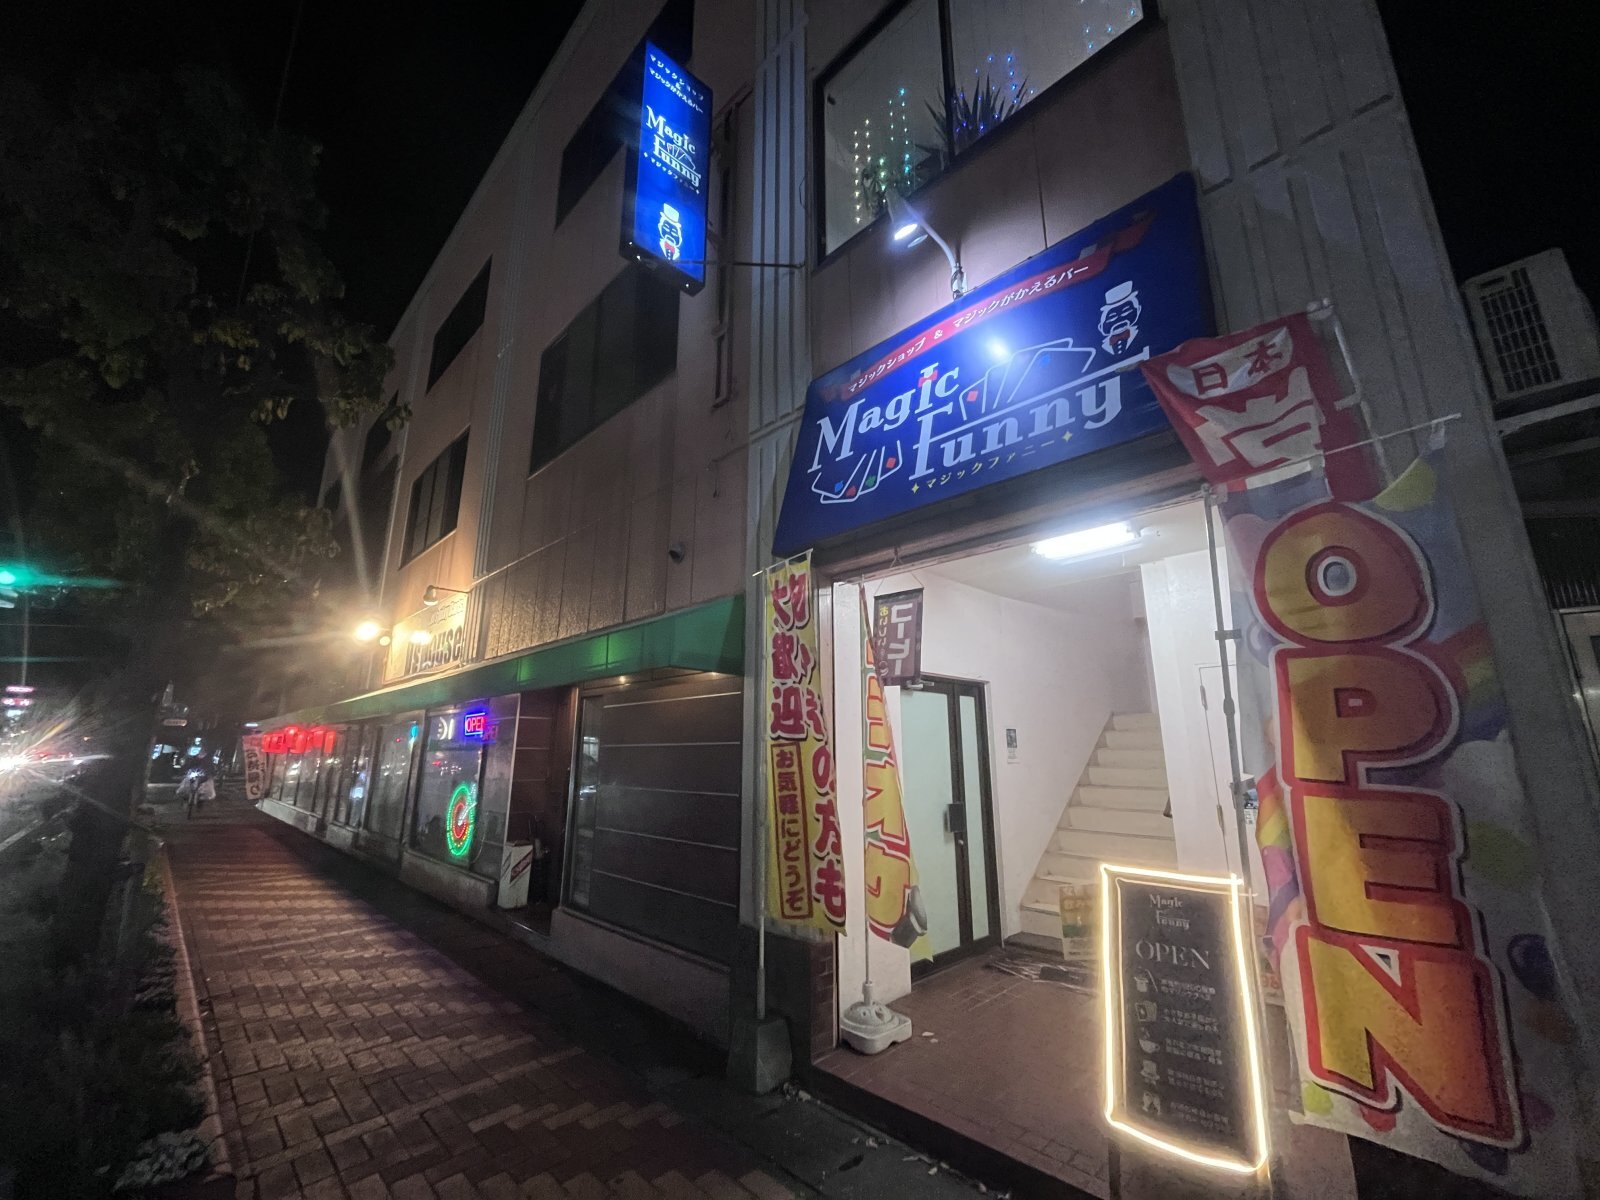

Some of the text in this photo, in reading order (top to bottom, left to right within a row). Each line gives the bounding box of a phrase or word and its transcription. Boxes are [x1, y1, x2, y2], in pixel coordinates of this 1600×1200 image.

[645, 105, 696, 154] Magic
[652, 134, 702, 188] Funny
[847, 263, 1090, 394] マジックショップ & マジックがかえるバー
[807, 361, 961, 474] Magic
[909, 352, 1148, 481] Funny
[924, 439, 1056, 489] マジックファニー
[775, 749, 807, 912] お気軽にどうぞ
[1254, 498, 1522, 1151] OPEN
[1149, 893, 1184, 909] Magic
[1135, 939, 1211, 971] OPEN
